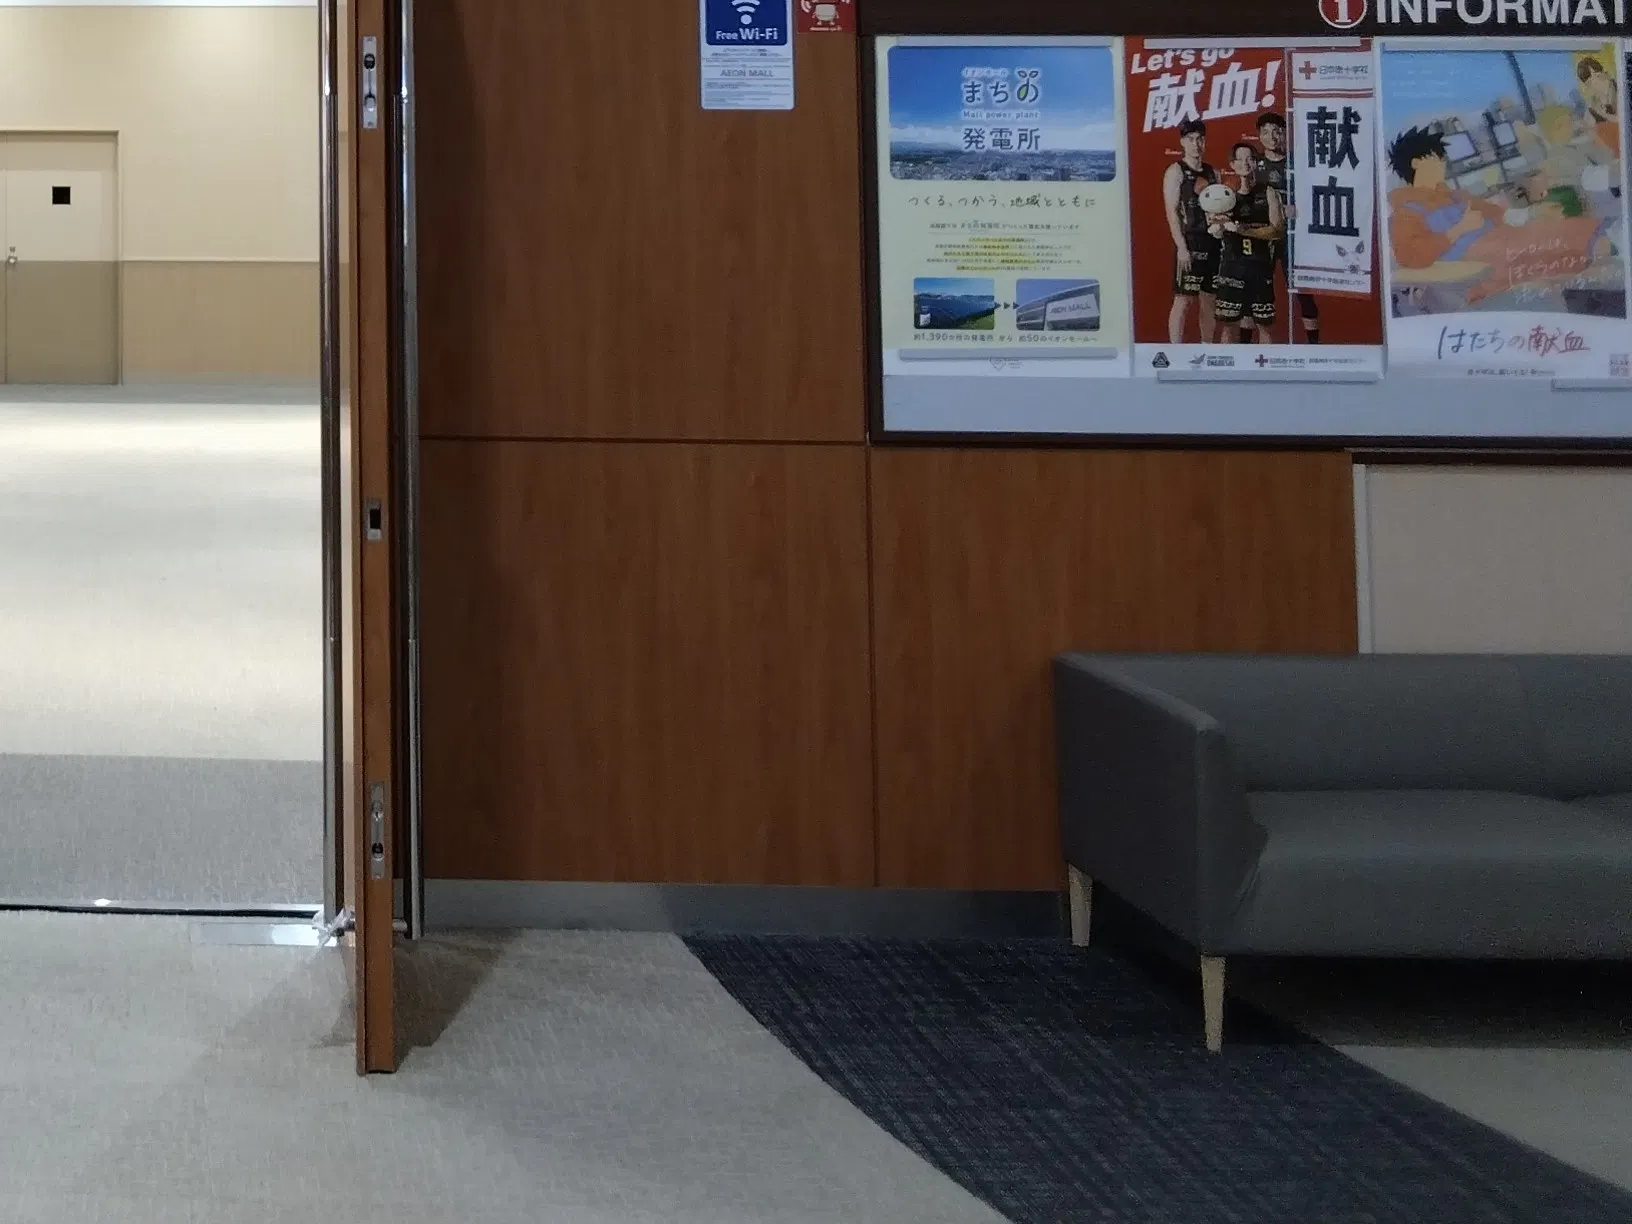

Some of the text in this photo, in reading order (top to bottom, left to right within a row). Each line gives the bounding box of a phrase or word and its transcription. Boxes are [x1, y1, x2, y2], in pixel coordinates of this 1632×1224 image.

[716, 28, 778, 40] Free Wi-Fi
[1131, 48, 1196, 74] Let's
[1143, 59, 1282, 133] 献血!
[985, 112, 1012, 121] power
[1015, 110, 1040, 121] plant
[963, 127, 1040, 151] 発電所
[1306, 105, 1362, 237] 献血
[1242, 238, 1253, 255] 9
[1438, 325, 1591, 360] はたちの献血
